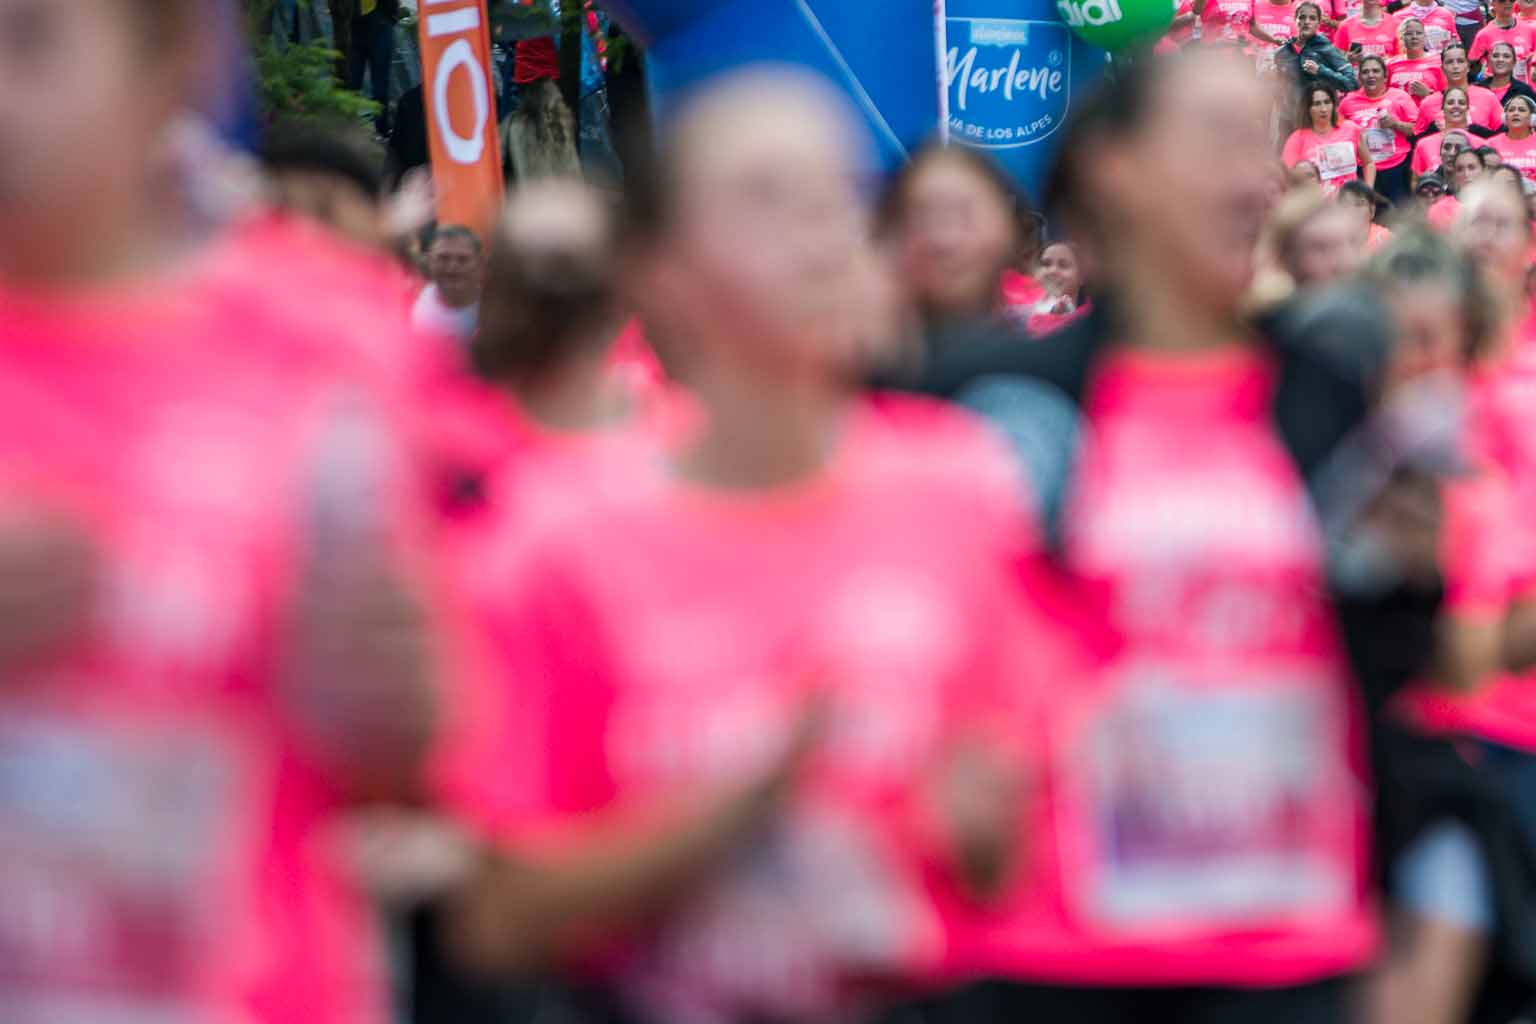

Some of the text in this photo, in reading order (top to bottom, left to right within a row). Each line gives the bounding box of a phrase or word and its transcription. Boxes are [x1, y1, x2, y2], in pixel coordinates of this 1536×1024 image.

[966, 123, 984, 137] DE
[987, 128, 1013, 139] LOS
[1016, 114, 1053, 137] ALPES
